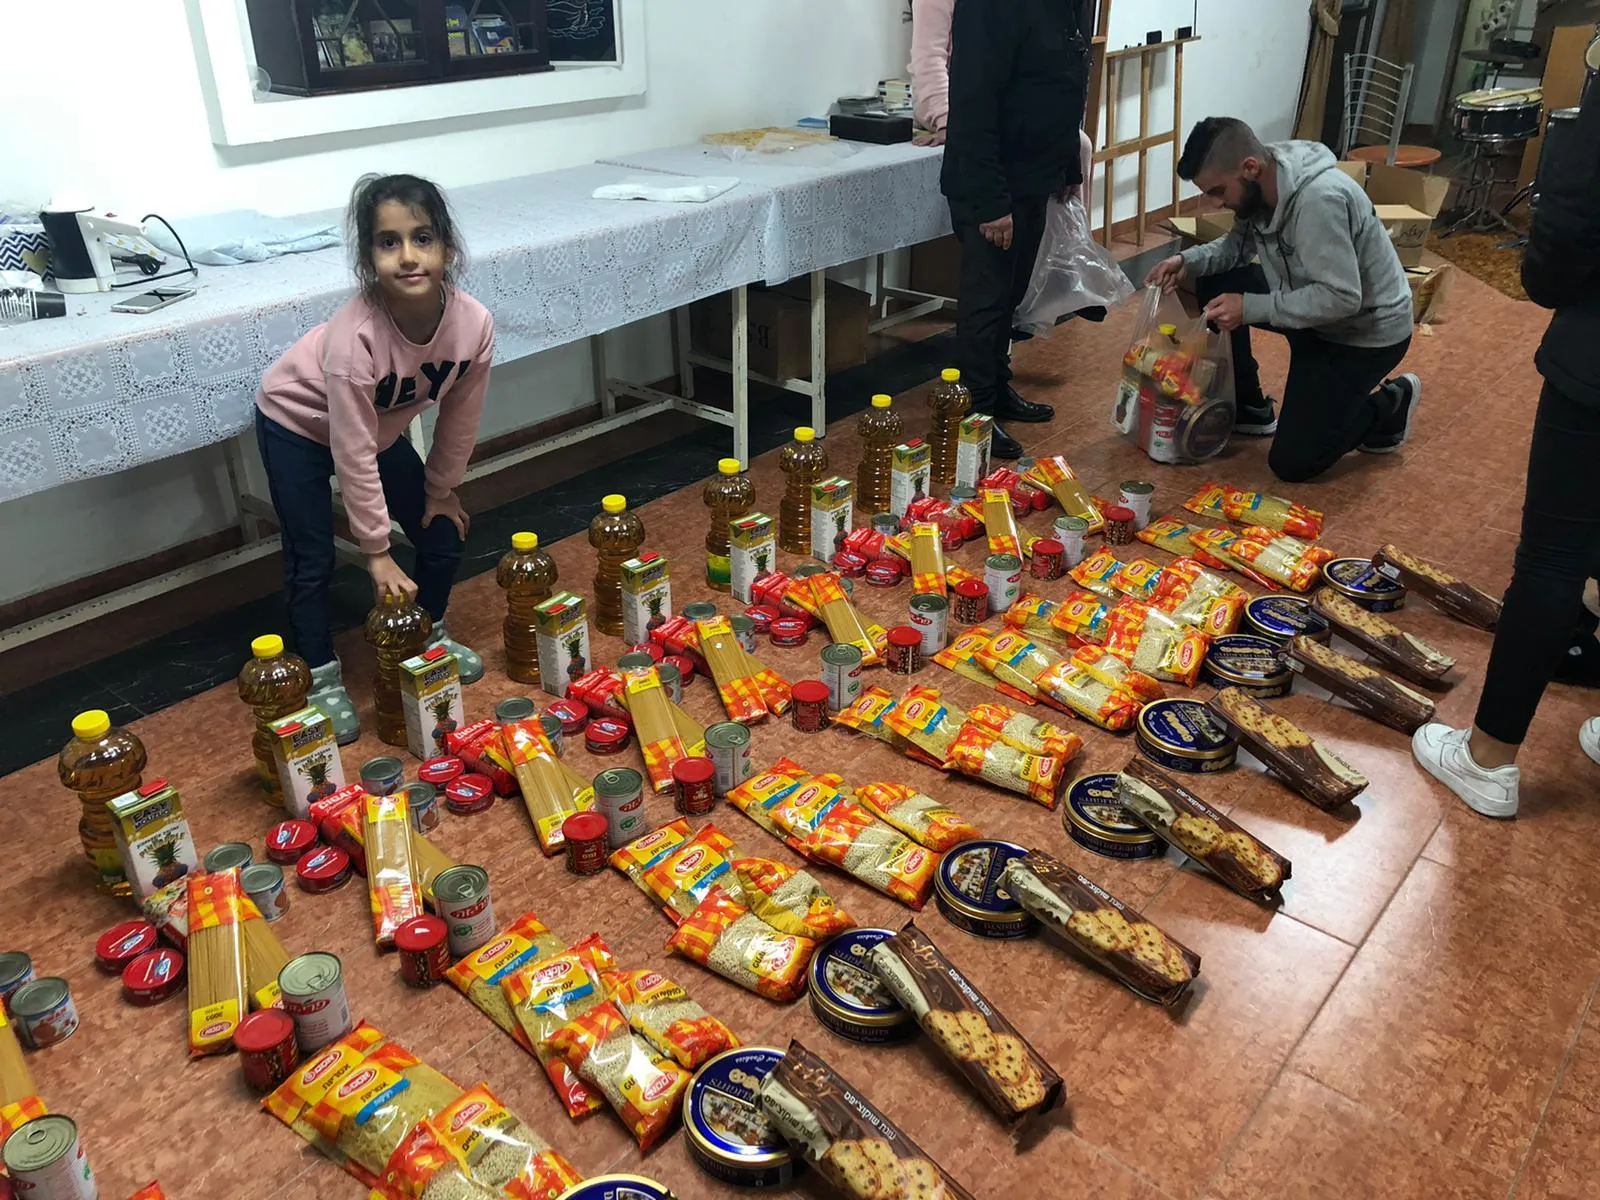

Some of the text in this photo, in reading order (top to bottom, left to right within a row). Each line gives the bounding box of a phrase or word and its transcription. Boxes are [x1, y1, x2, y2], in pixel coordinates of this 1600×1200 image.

[453, 719, 493, 739] CIGALA
[317, 785, 364, 809] CIGALA
[798, 788, 817, 804] אסם
[643, 832, 662, 846] אסם
[681, 852, 700, 869] אסם
[691, 862, 714, 881] אטריות
[484, 940, 509, 959] אסם
[493, 949, 521, 970] אטריות
[314, 1053, 337, 1075] אסם
[322, 1064, 351, 1091] אטריות
[350, 1071, 374, 1091] אסם
[360, 1082, 388, 1104] אטריות
[709, 1078, 757, 1101] ELIGHTS
[460, 1103, 484, 1120] אסם
[879, 1123, 897, 1141] עוגת
